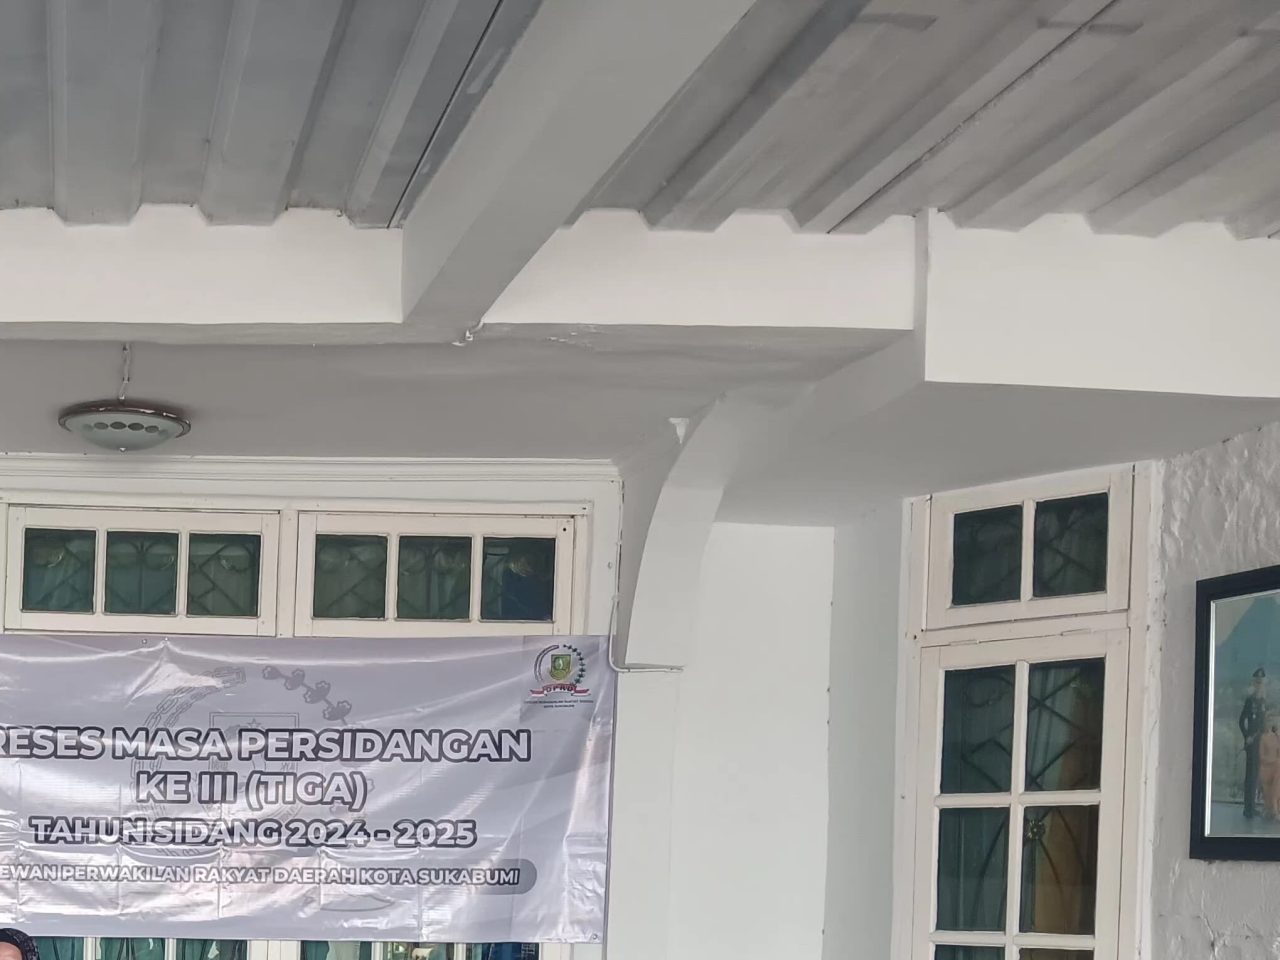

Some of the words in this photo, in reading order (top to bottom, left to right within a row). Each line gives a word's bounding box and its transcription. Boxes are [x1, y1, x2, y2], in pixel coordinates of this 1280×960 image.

[112, 727, 232, 760] MASA
[239, 728, 532, 762] PERSIDANGAN
[136, 771, 191, 803] KE
[198, 771, 237, 803] III
[246, 771, 368, 812] (TIGA)
[28, 816, 152, 844] TAHUN
[153, 818, 282, 847] SIDANG
[285, 819, 368, 847] 2024
[393, 819, 478, 848] 2025
[62, 865, 191, 883] PERWAKILAN
[193, 867, 270, 884] RAKYAT
[273, 868, 357, 884] DAERAH
[358, 868, 419, 885] KOTA
[418, 868, 521, 885] SUKABUMI
